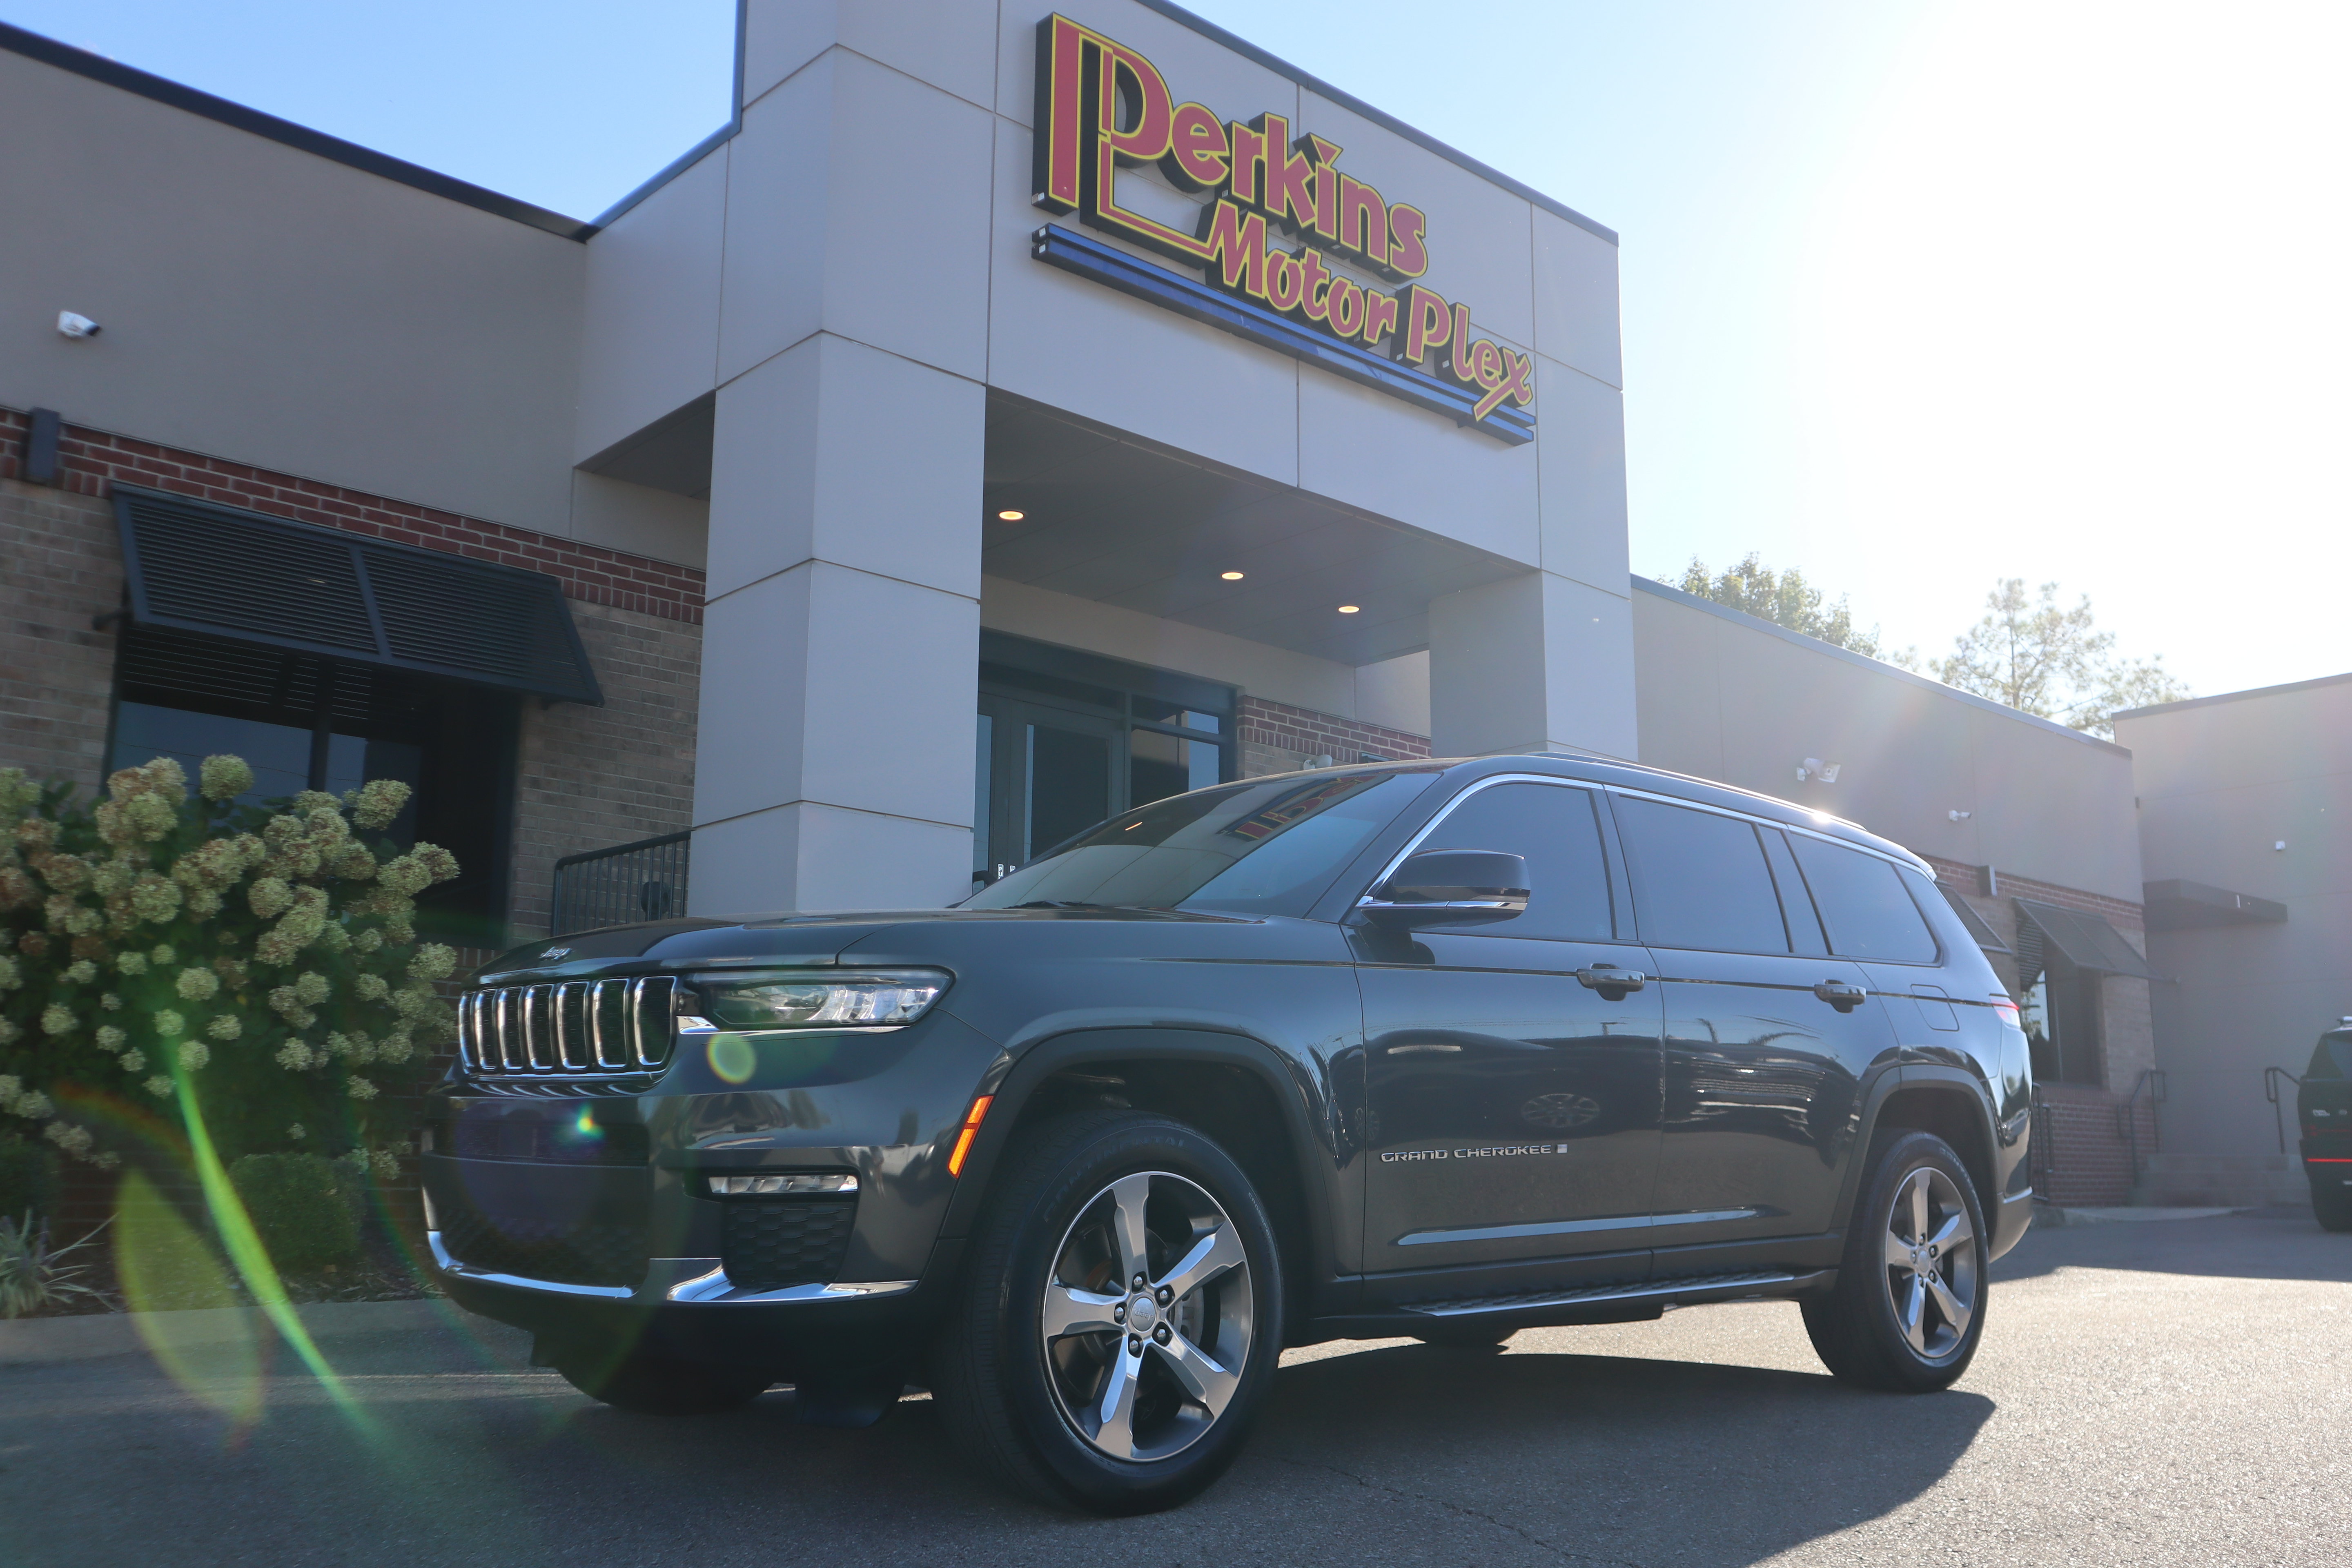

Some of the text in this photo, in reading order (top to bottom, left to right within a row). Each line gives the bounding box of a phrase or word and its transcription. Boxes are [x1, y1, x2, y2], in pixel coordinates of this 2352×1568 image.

[1048, 12, 1428, 278] Perkins
[1205, 198, 1533, 422] Motor Plex
[538, 946, 571, 960] Jeep
[1381, 1149, 1448, 1163] GRAND
[1453, 1145, 1552, 1158] CHEROKEE
[1135, 1308, 1154, 1322] Jeep
